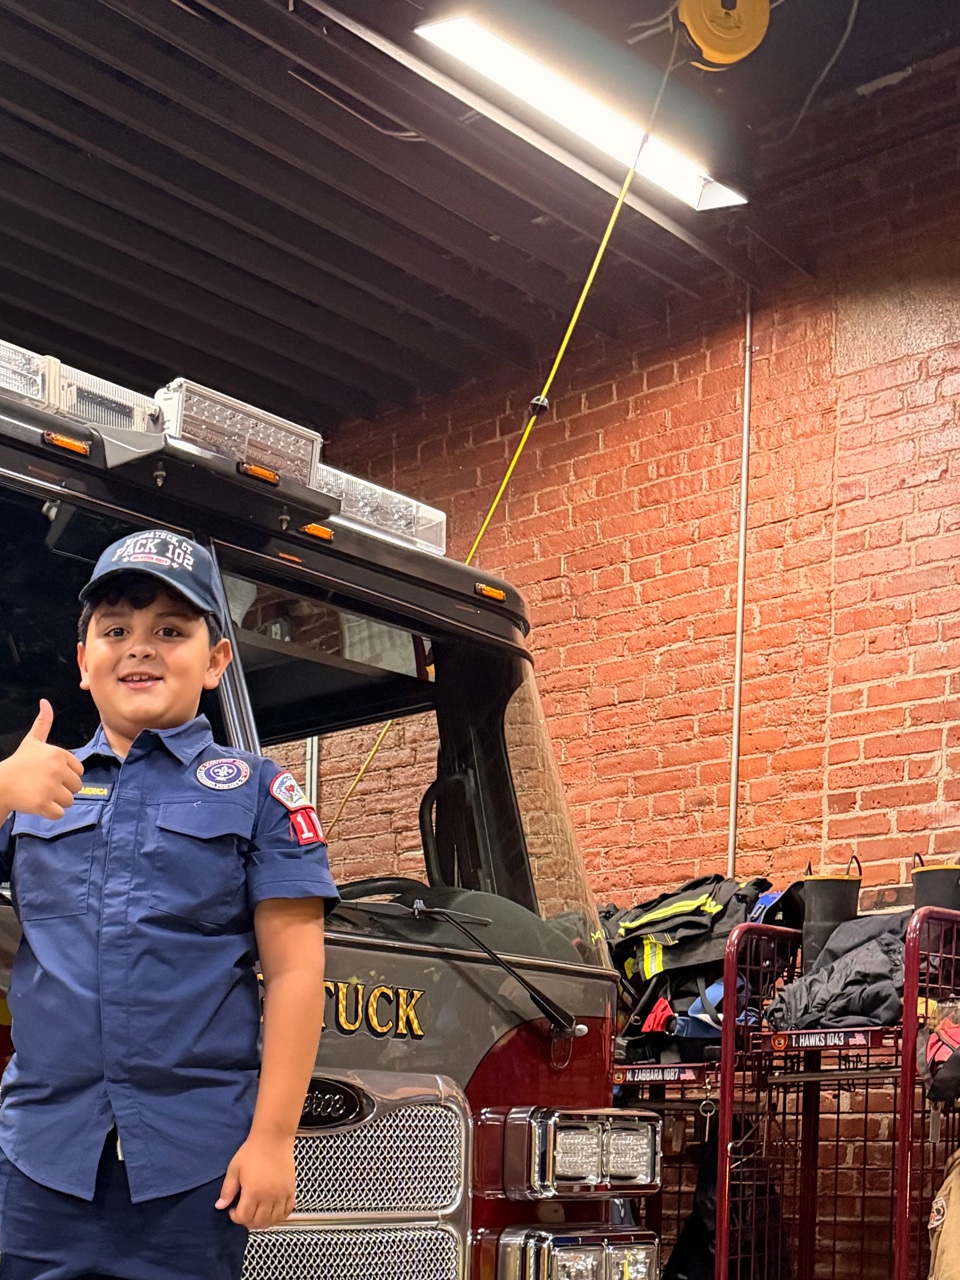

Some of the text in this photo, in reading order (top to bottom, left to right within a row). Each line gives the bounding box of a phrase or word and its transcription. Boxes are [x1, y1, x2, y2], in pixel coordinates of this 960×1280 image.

[112, 539, 194, 571] PACK 102
[791, 1033, 845, 1048] T. HAWKS 1043
[626, 1069, 634, 1082] M.
[664, 1067, 679, 1080] 1087
